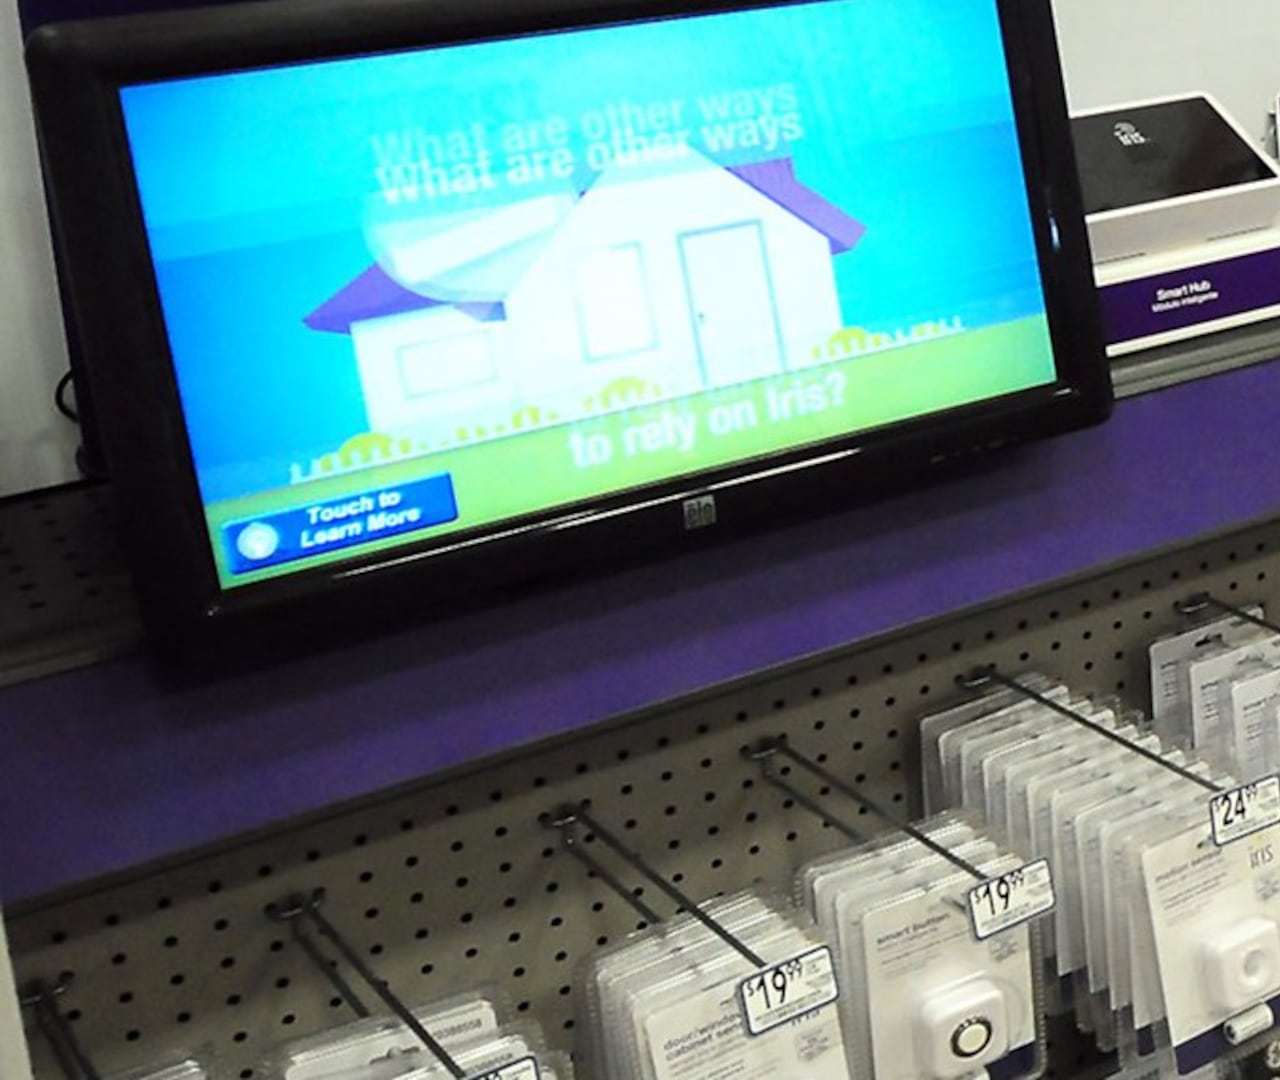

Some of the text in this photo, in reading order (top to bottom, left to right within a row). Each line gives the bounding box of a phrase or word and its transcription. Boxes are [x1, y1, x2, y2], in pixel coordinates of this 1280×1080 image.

[570, 373, 847, 469] to rely on Iris?
[308, 491, 400, 524] Touch to
[302, 509, 420, 548] Learn More
